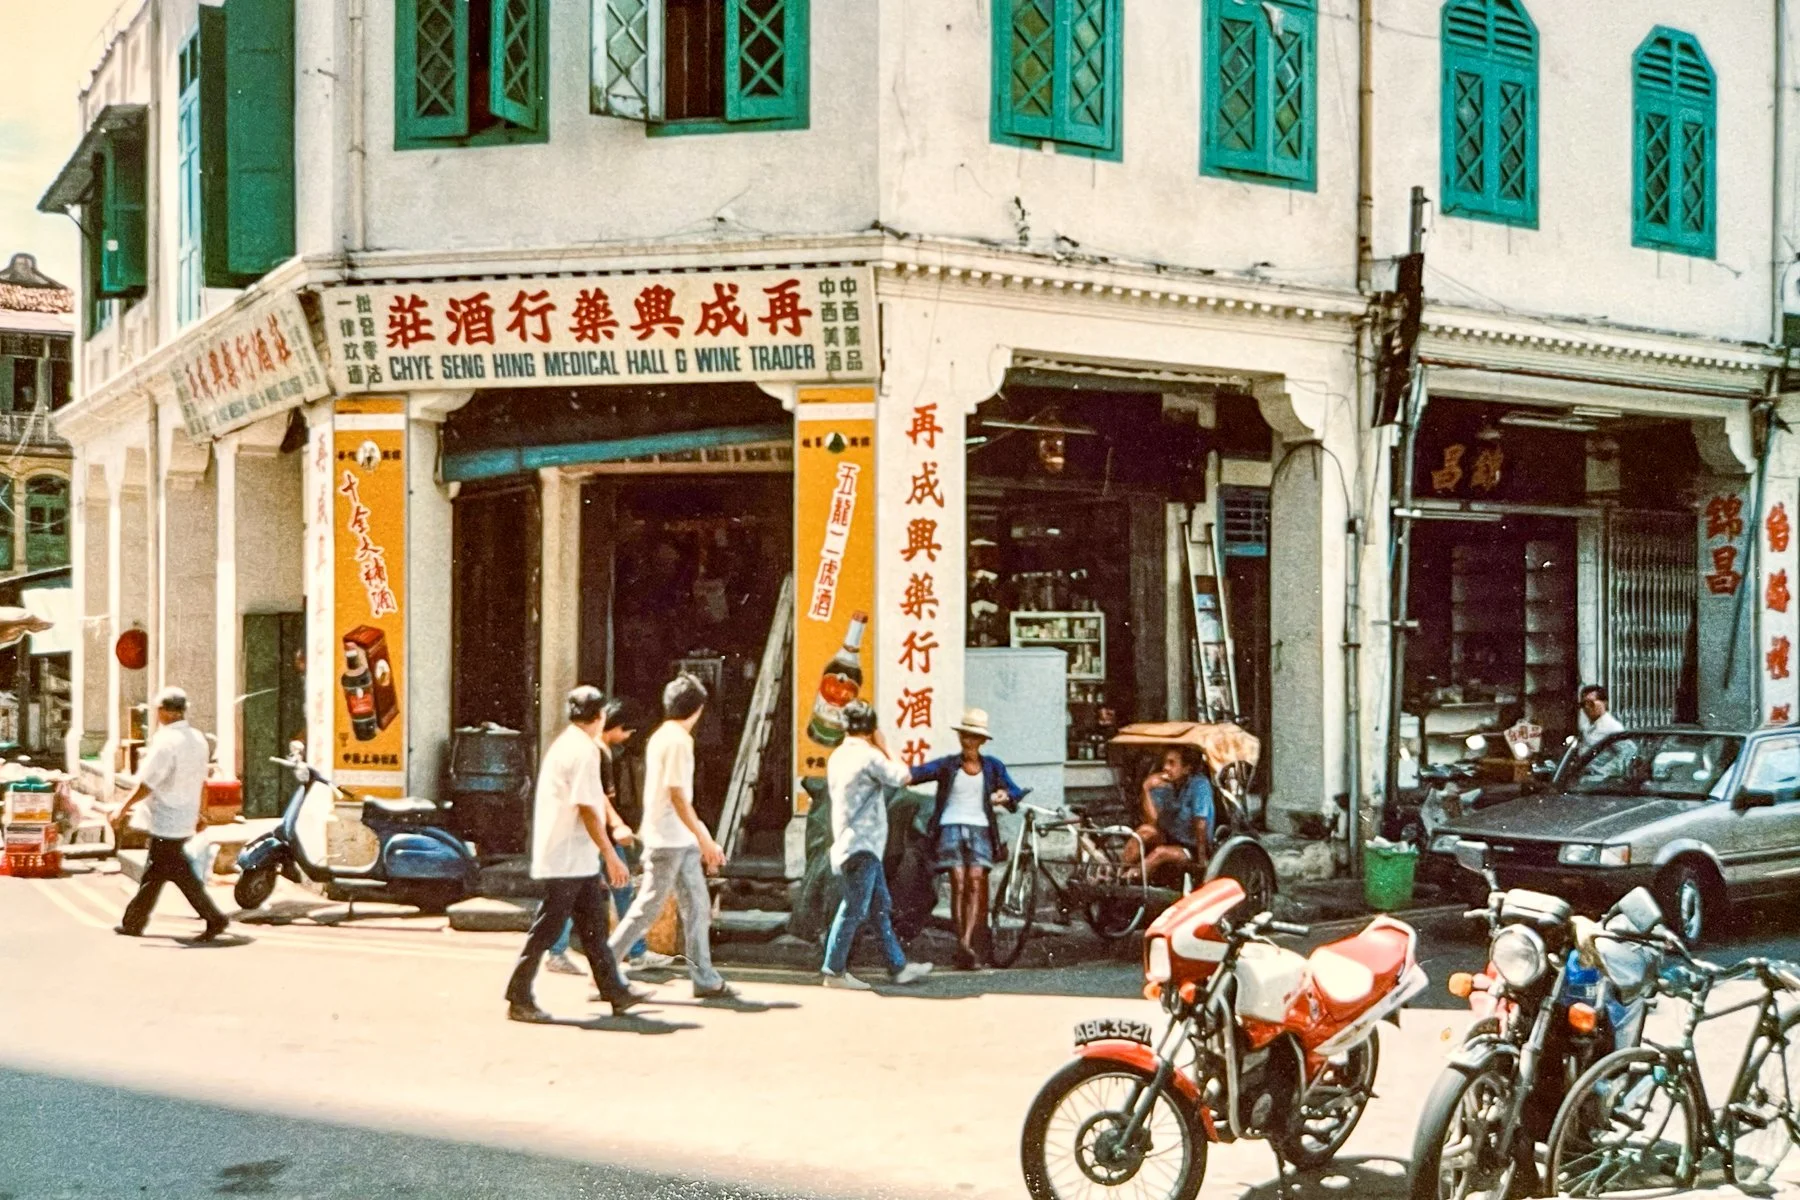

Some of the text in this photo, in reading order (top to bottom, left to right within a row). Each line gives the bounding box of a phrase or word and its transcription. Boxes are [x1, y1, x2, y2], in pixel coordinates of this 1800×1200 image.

[389, 355, 434, 381] CHYE
[441, 354, 486, 380] SENG
[493, 352, 536, 378] HING
[545, 350, 620, 377] MEDICAL
[626, 349, 669, 375] HALL
[695, 347, 741, 373] WINE
[749, 343, 816, 372] TRADER
[1075, 1018, 1151, 1043] ABC3521
